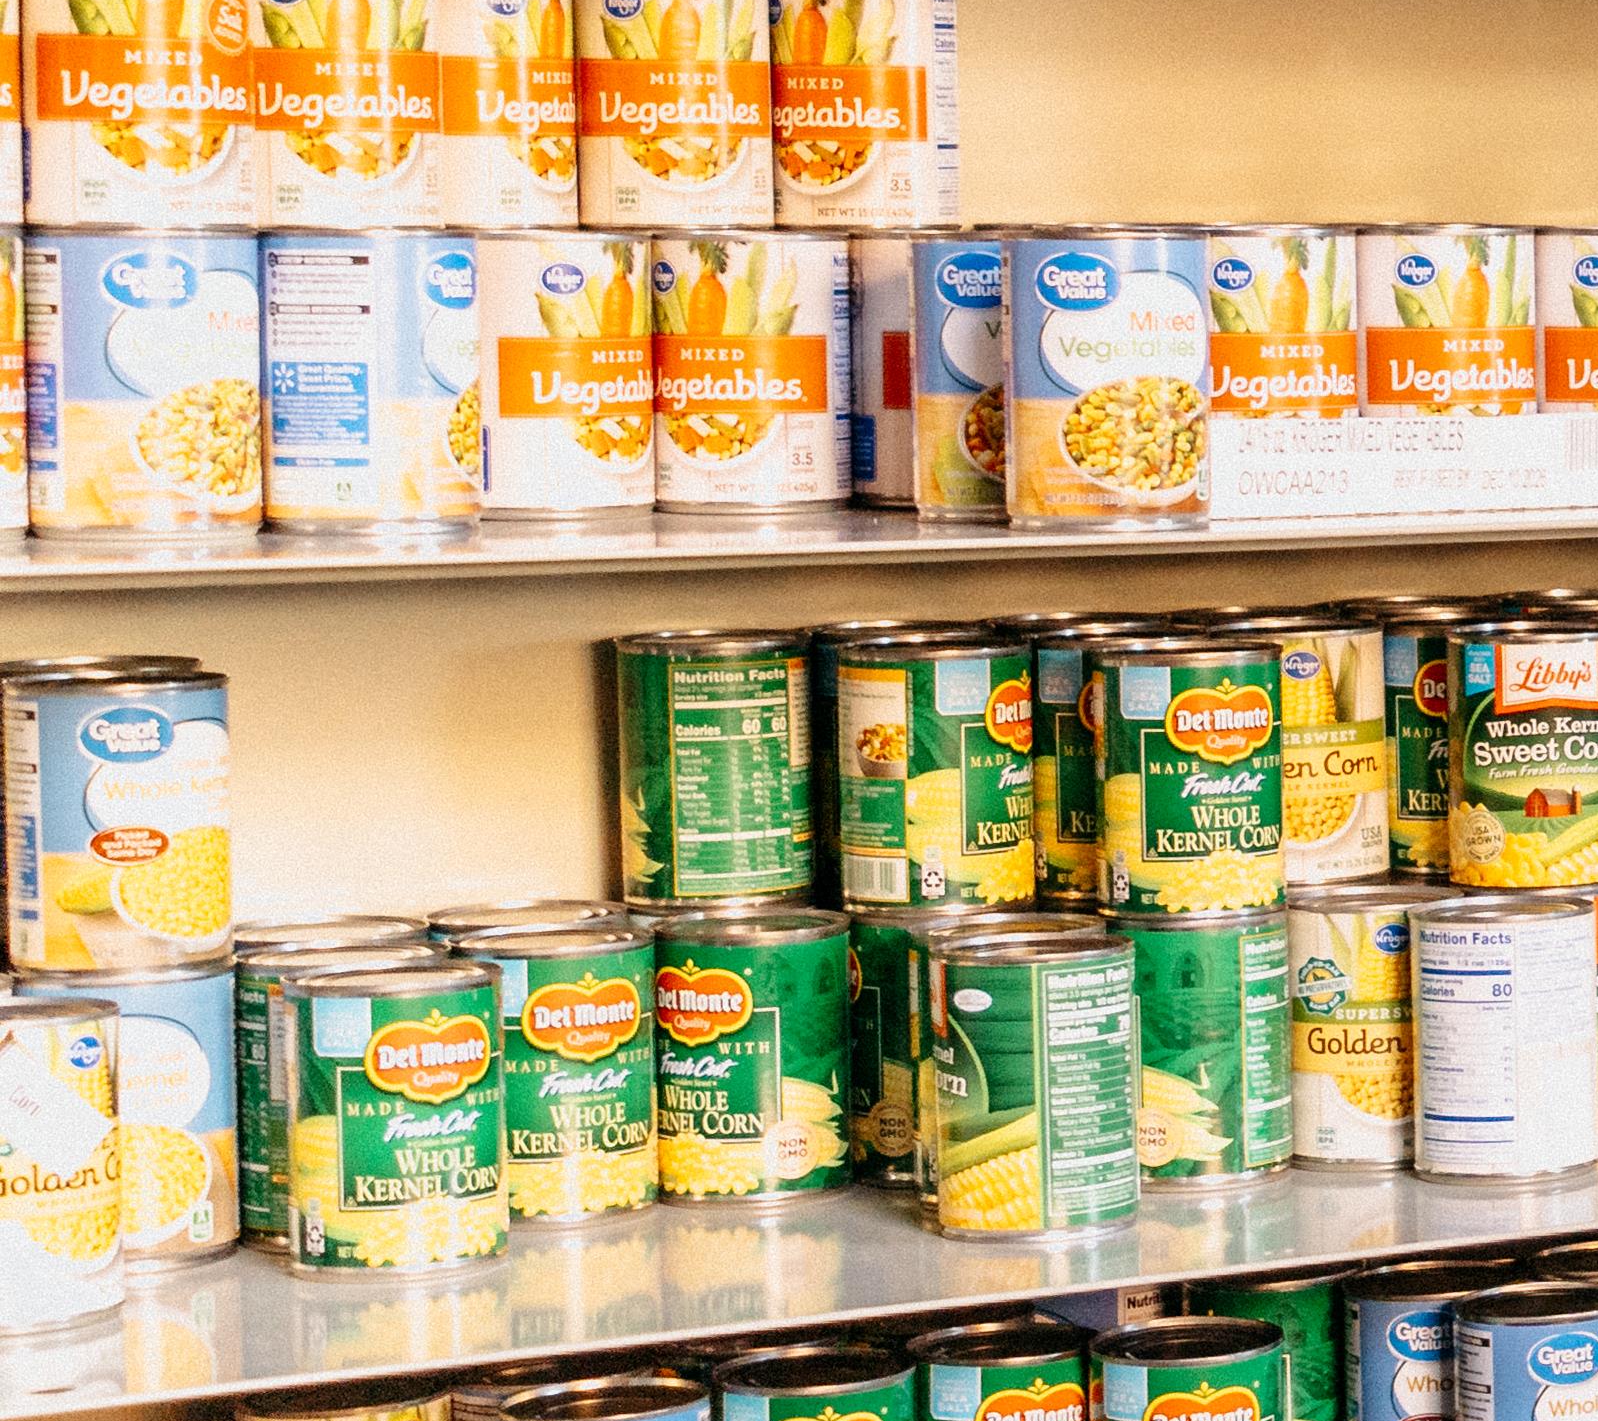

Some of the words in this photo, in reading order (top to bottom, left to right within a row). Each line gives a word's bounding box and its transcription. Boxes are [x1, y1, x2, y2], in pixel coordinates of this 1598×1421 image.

[125, 50, 203, 66] MIXED
[650, 72, 717, 86] MIXED
[1043, 262, 1106, 287] Great
[1068, 282, 1107, 300] Value
[1129, 310, 1195, 333] Mixed
[1058, 335, 1197, 364] Vegetables
[1444, 338, 1505, 353] MIXED
[674, 670, 738, 683] Nutrition
[743, 668, 786, 680] Facts
[1518, 660, 1591, 691] Libby's
[1176, 713, 1211, 731] Del
[1214, 707, 1269, 729] Monte
[1486, 717, 1549, 737] Whole
[675, 724, 721, 736] Calories
[1206, 734, 1246, 751] Quality
[1474, 739, 1555, 766] Sweet
[1192, 807, 1261, 827] WHOLE
[1158, 829, 1231, 852] KERNEL
[1234, 826, 1279, 849] CORN
